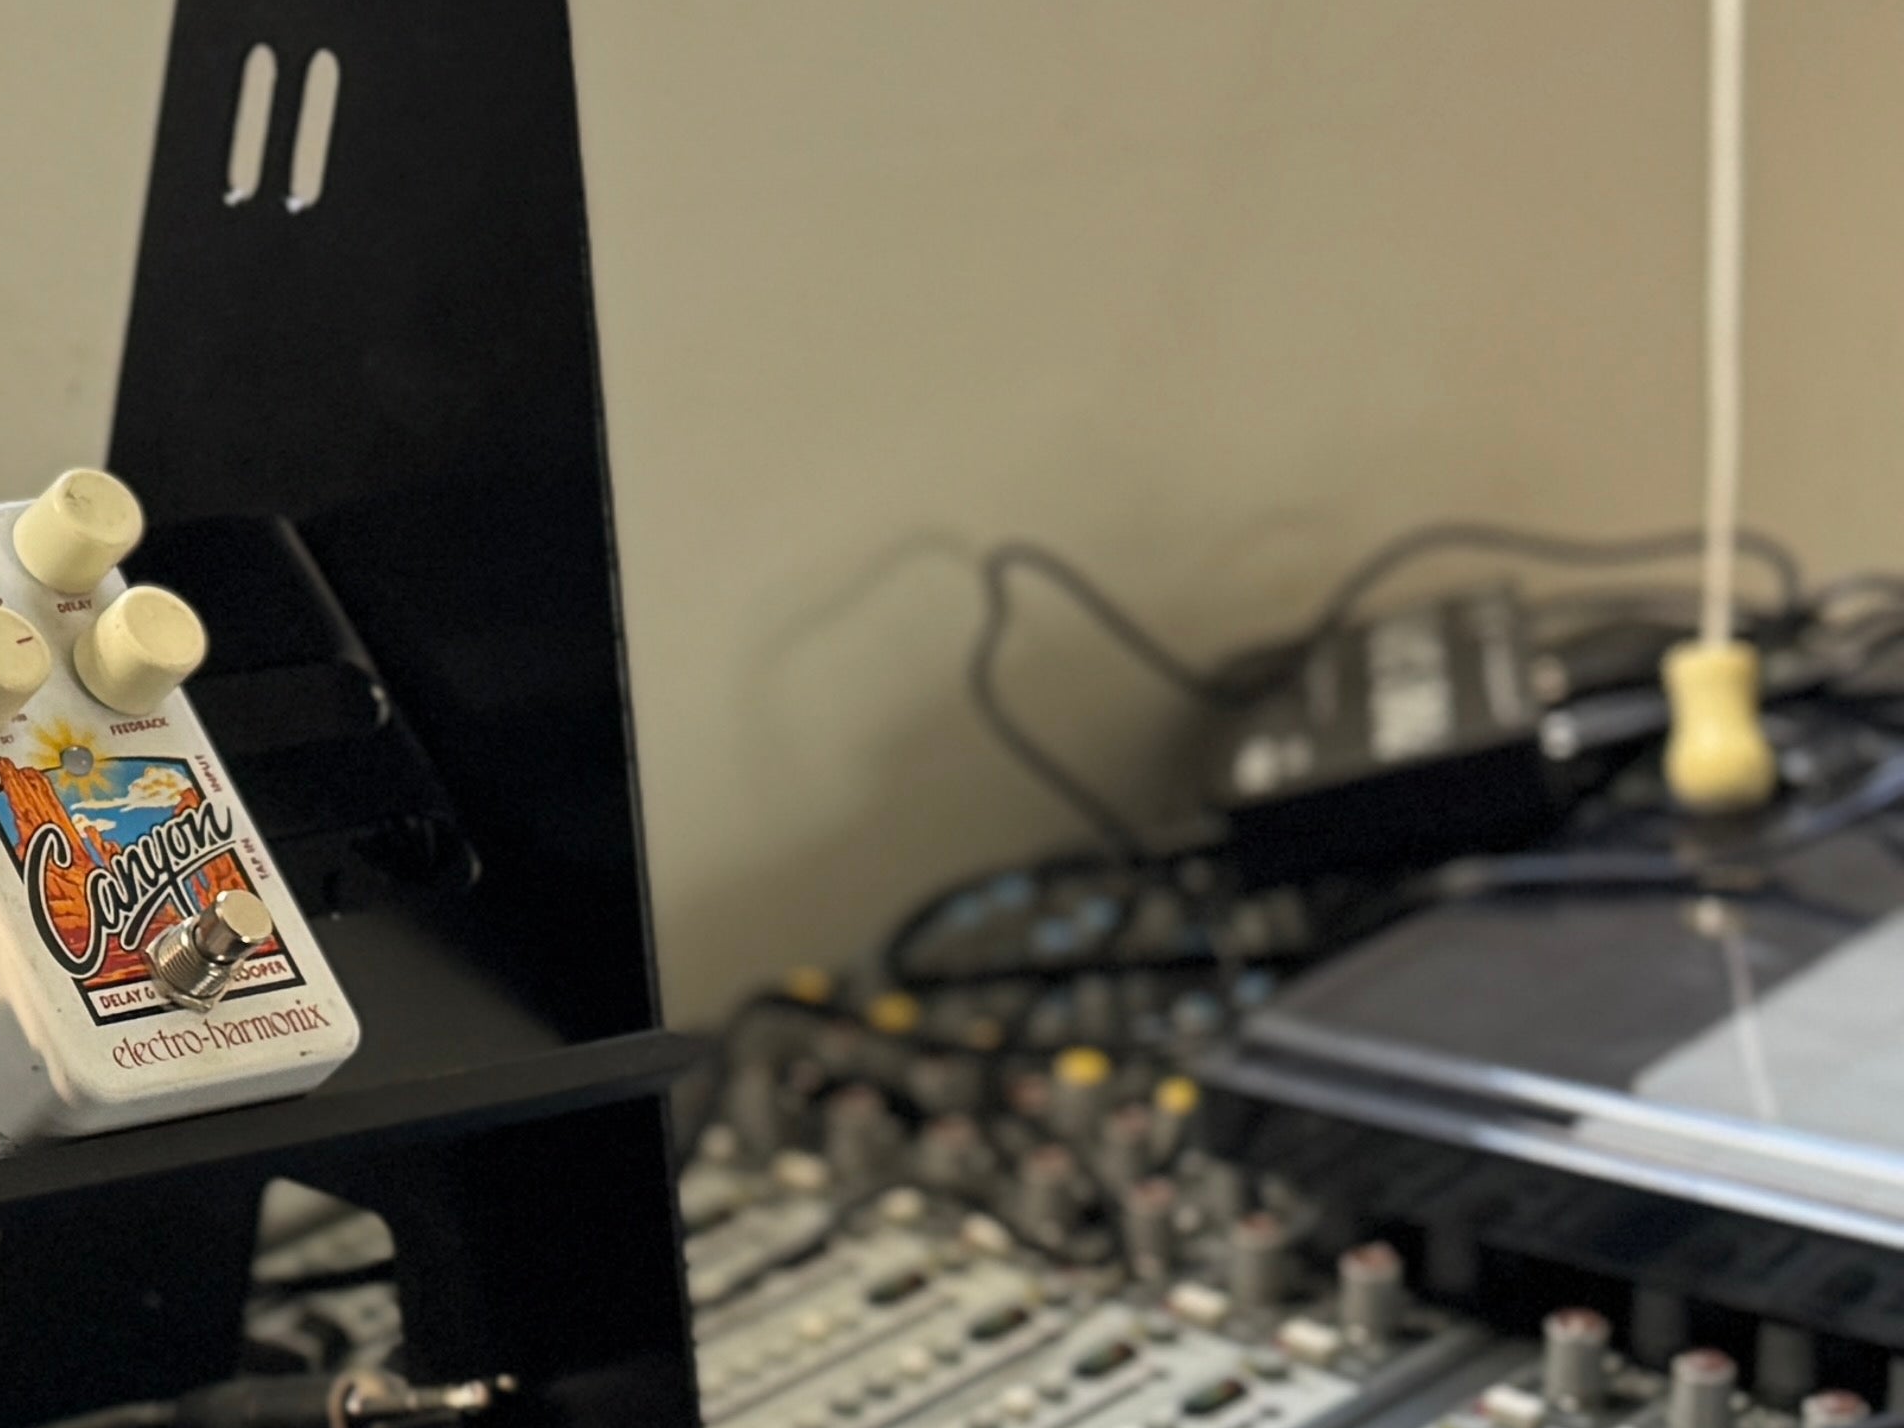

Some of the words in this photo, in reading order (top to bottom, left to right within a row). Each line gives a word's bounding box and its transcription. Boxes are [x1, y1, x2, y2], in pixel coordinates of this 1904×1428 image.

[109, 718, 169, 736] FEEDBACK
[194, 753, 223, 794] INPUT
[26, 802, 233, 977] Canyon
[99, 989, 142, 1010] DELAY
[112, 999, 331, 1069] electro-harmonix
